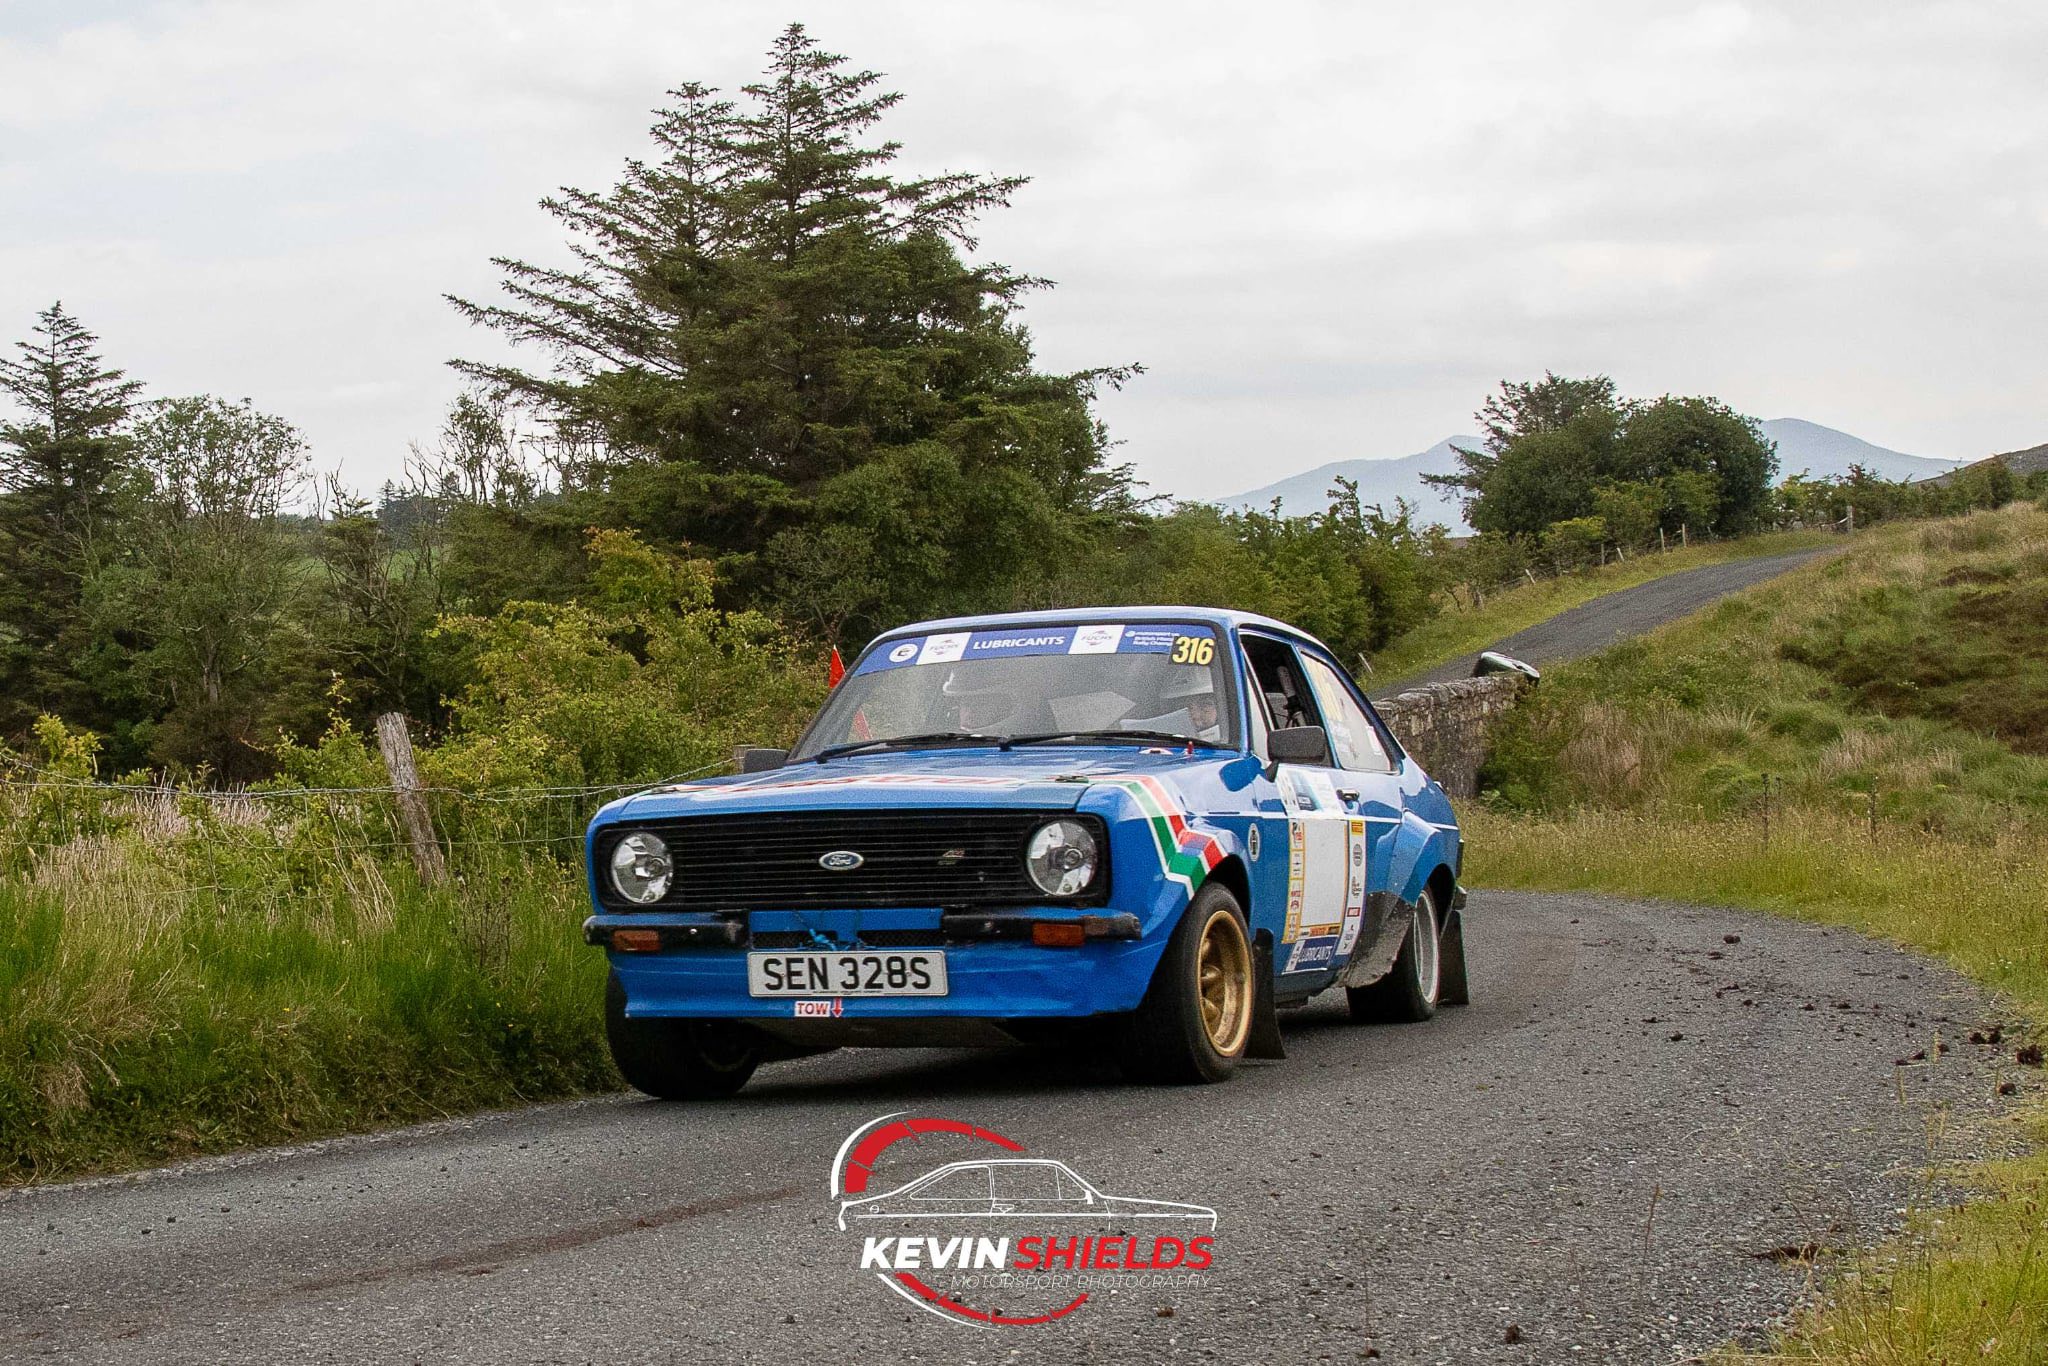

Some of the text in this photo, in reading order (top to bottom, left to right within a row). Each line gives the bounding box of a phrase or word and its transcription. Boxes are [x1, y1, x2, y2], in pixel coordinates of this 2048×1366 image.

[972, 635, 1066, 650] LUBRICANTS
[1172, 636, 1215, 666] 316
[828, 854, 853, 866] Ford
[763, 956, 932, 991] SEN 328S
[796, 1003, 829, 1015] TOW
